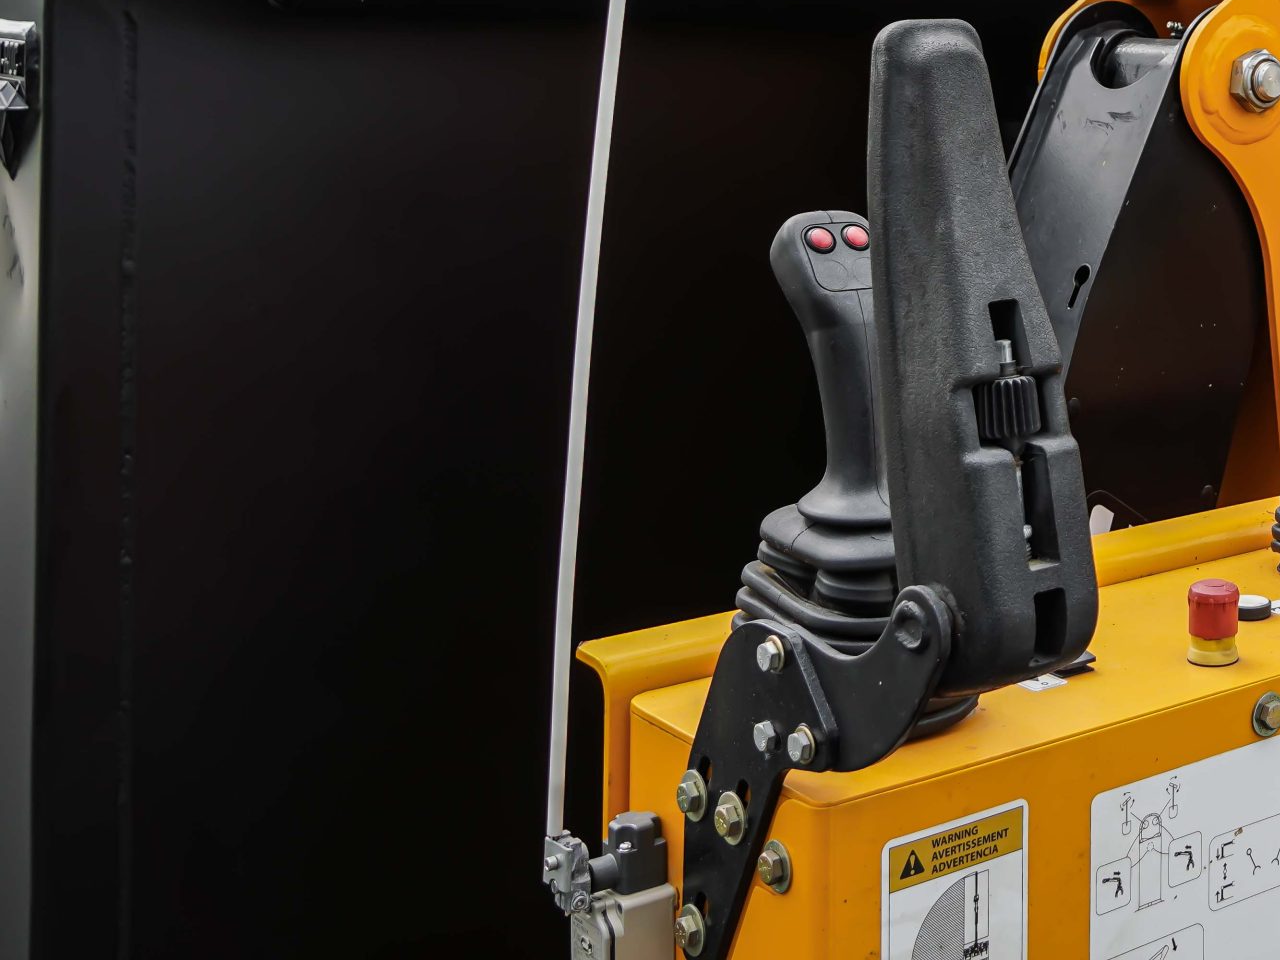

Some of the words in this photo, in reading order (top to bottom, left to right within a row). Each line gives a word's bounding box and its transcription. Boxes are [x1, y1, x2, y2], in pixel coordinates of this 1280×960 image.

[931, 825, 979, 849] WARNING
[931, 827, 1010, 862] AVERTISSEMENT
[931, 844, 999, 875] ADVERTENCIA
